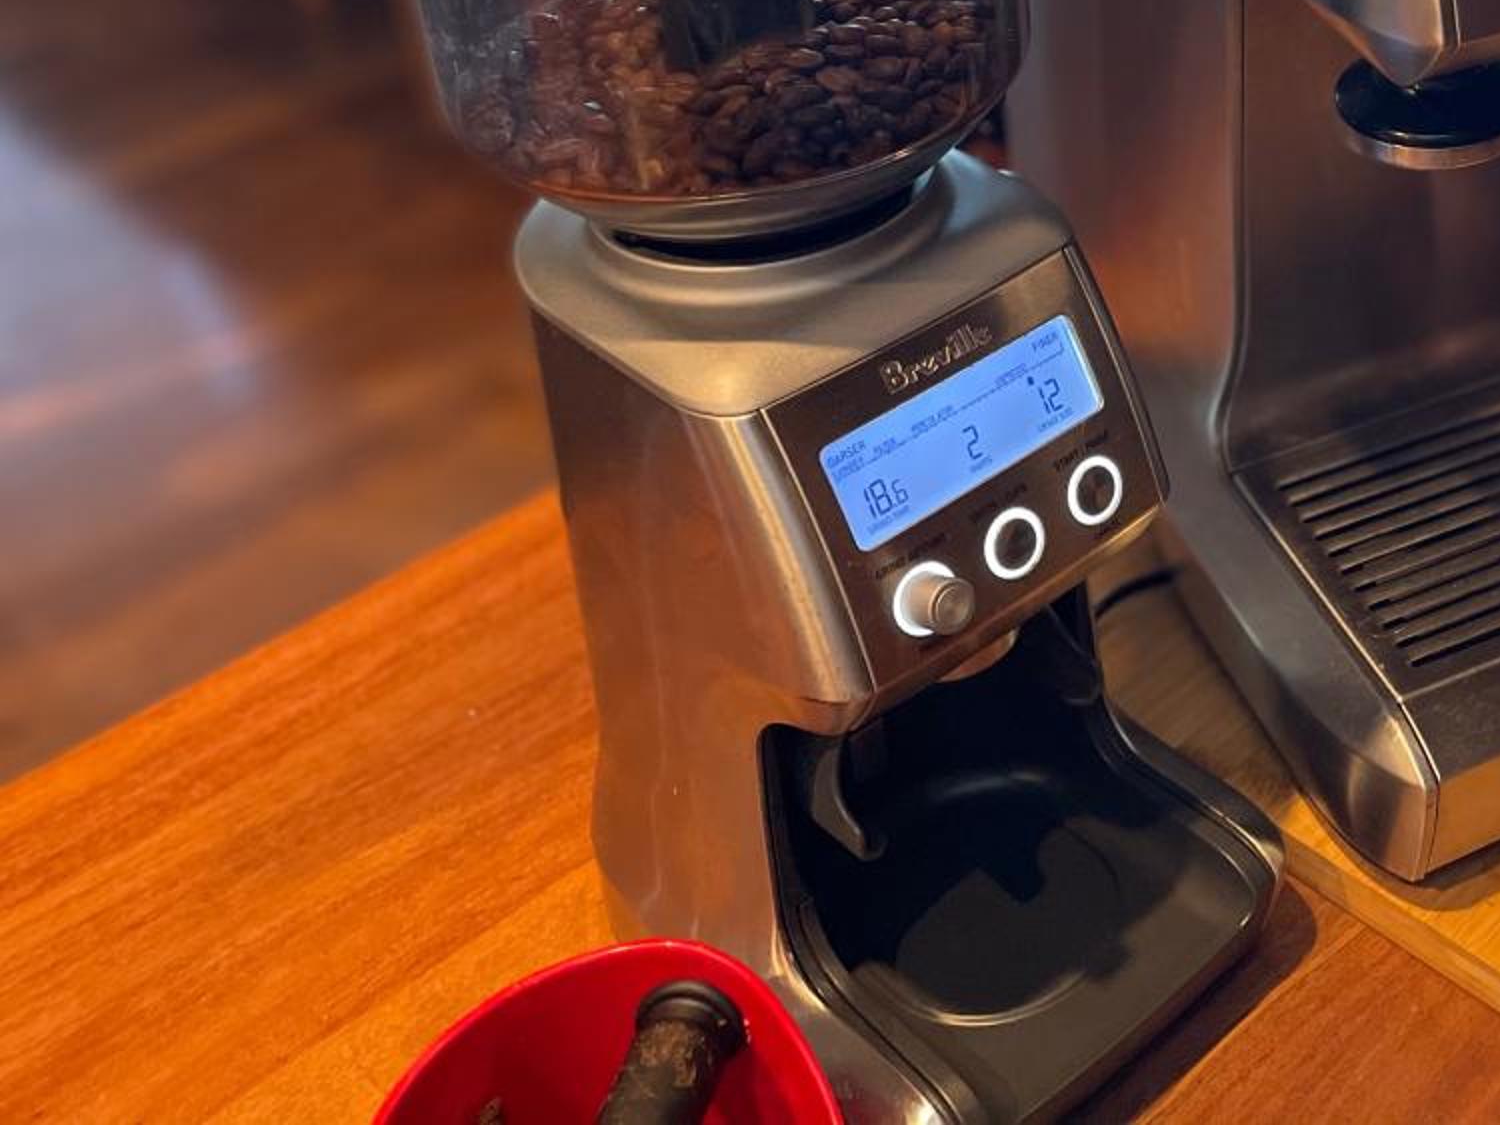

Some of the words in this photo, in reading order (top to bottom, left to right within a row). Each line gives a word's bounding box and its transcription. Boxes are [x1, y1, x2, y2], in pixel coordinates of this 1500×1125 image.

[879, 322, 993, 395] Breville
[862, 478, 909, 520] 18.6
[962, 425, 985, 461] 2
[1038, 378, 1064, 414] 12
